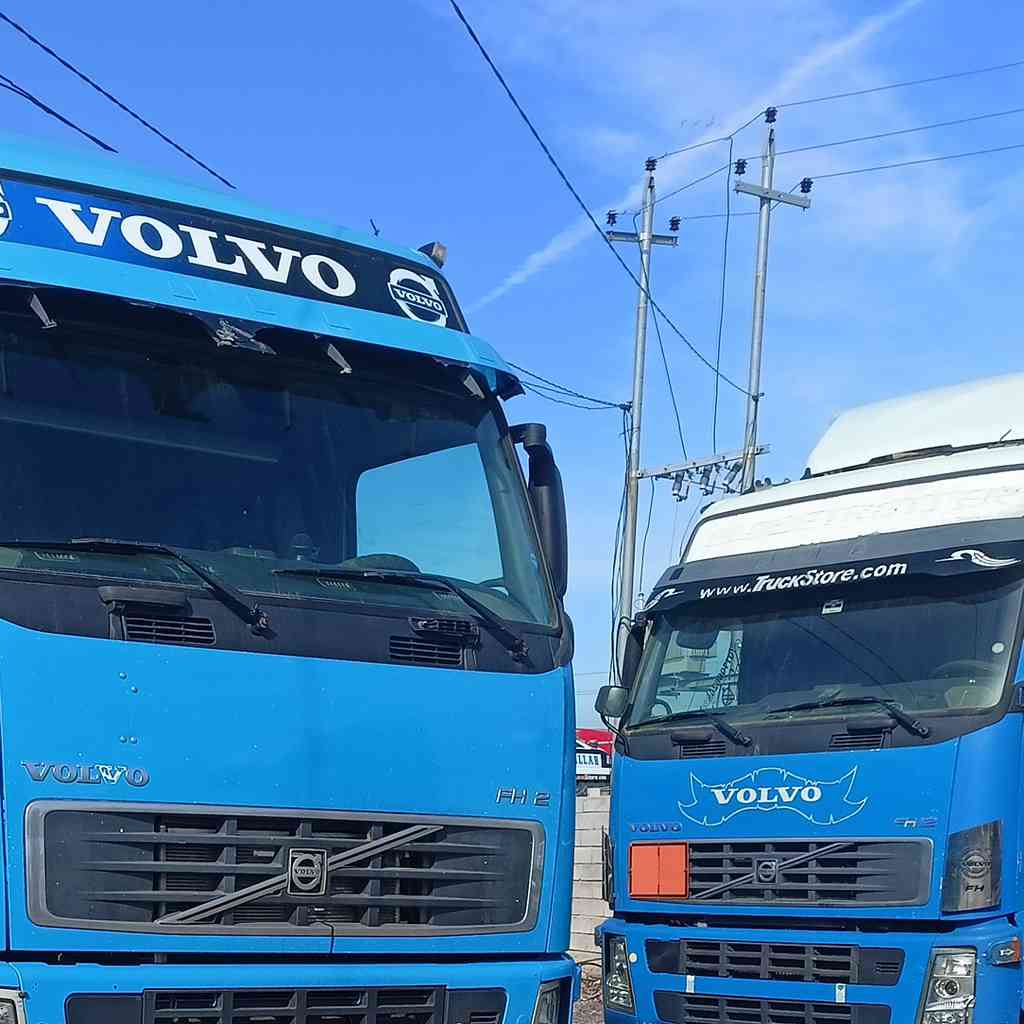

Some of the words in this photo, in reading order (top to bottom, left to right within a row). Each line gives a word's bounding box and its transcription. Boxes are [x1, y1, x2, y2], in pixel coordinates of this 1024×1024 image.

[35, 196, 357, 297] VOLVO
[393, 287, 443, 311] VOLVO
[19, 761, 151, 787] VOLVO
[711, 786, 822, 804] VOLVO
